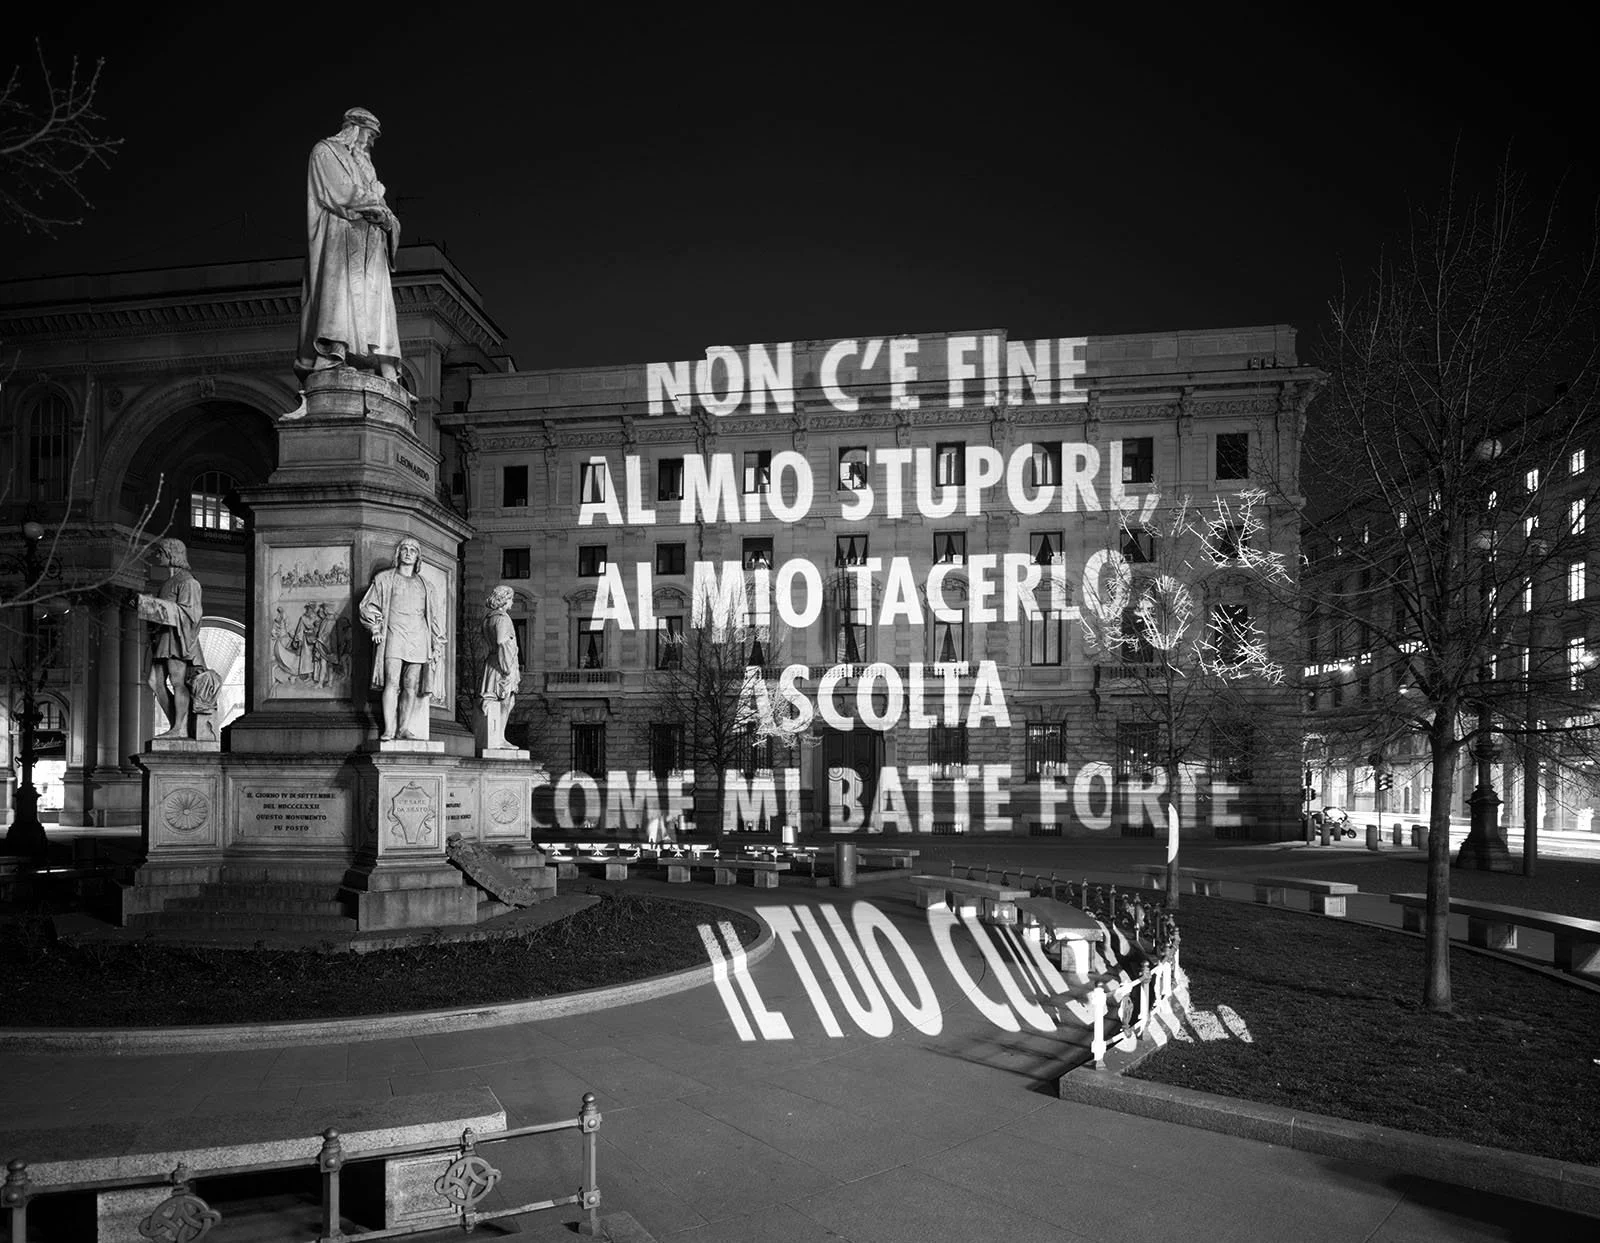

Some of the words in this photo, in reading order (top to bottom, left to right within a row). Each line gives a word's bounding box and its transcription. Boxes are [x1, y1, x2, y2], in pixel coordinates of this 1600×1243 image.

[646, 342, 795, 416] NON
[947, 335, 1089, 408] FINE
[578, 455, 656, 525] AL
[680, 450, 814, 523] MIO
[589, 562, 667, 630] AL
[690, 558, 823, 634] MIO
[735, 660, 1012, 732] ASCOLTA
[722, 767, 801, 833] MI
[828, 764, 1013, 834] BATTE
[1037, 761, 1243, 831] FORTE
[697, 921, 794, 1041] IL
[754, 901, 943, 1038] TUO
